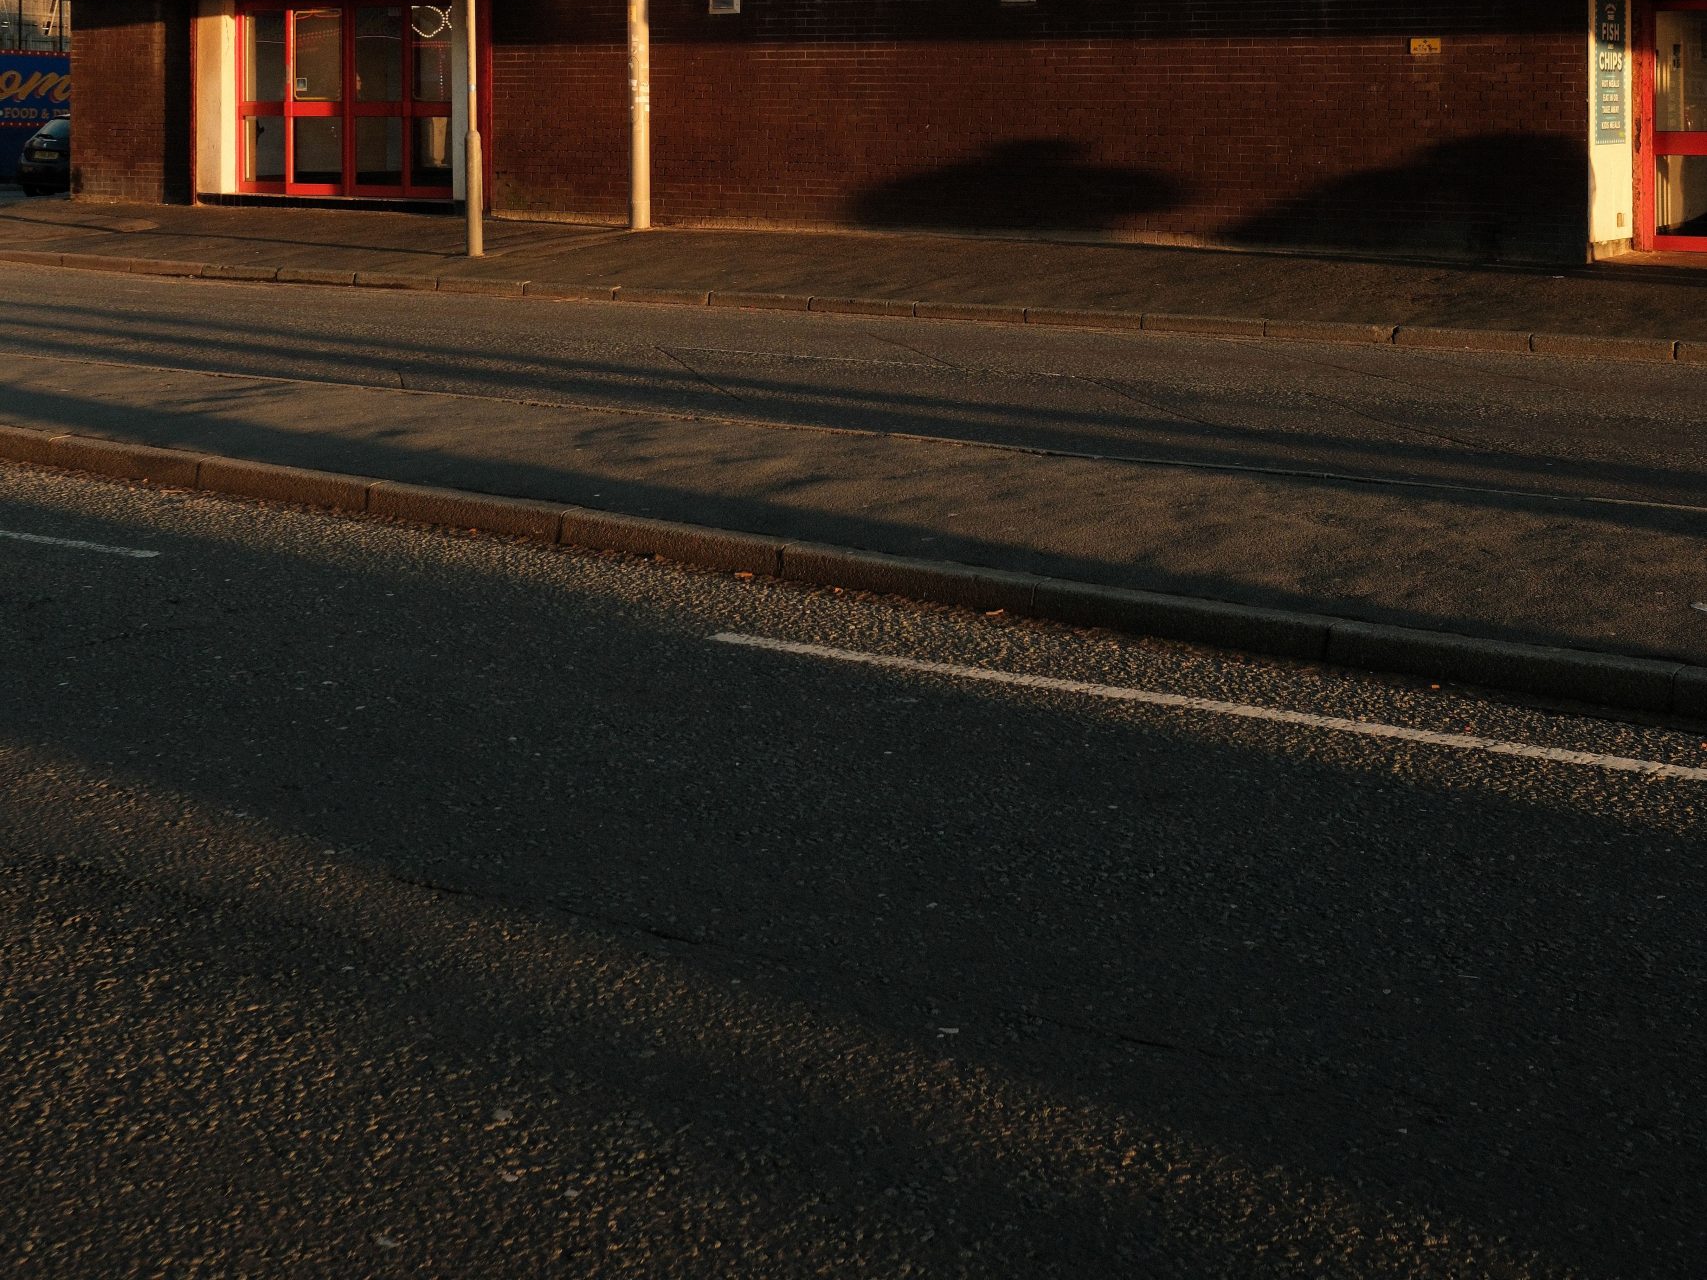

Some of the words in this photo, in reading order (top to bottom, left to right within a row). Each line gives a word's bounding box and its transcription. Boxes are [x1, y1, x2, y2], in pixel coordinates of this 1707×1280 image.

[1601, 22, 1620, 41] FISH
[1599, 51, 1623, 71] CHIPS
[3, 108, 38, 119] FOOD
